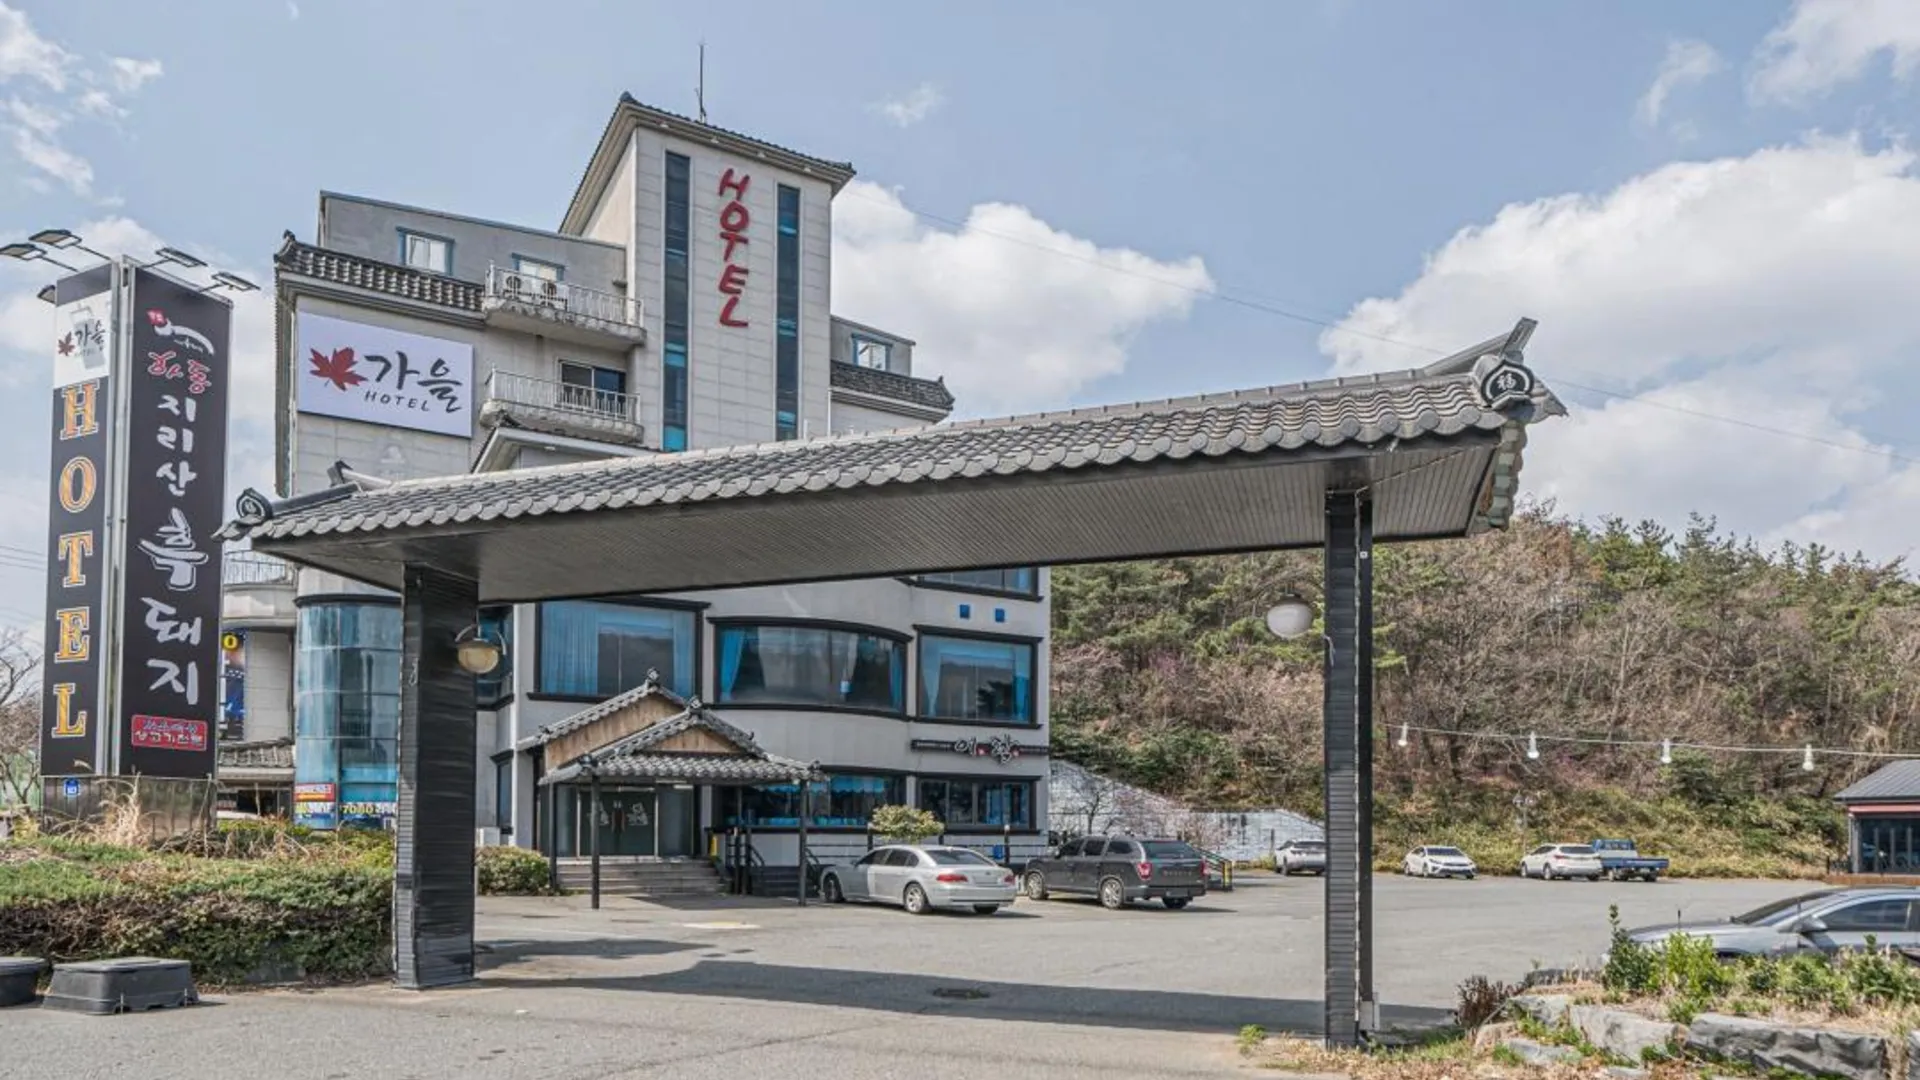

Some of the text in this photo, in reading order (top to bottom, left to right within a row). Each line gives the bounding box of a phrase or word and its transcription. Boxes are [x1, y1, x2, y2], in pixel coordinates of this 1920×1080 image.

[717, 168, 751, 328] HOTEL
[75, 320, 105, 351] 가을
[364, 350, 463, 413] 가을
[364, 391, 431, 412] HOTEL
[52, 379, 100, 738] HOTEL
